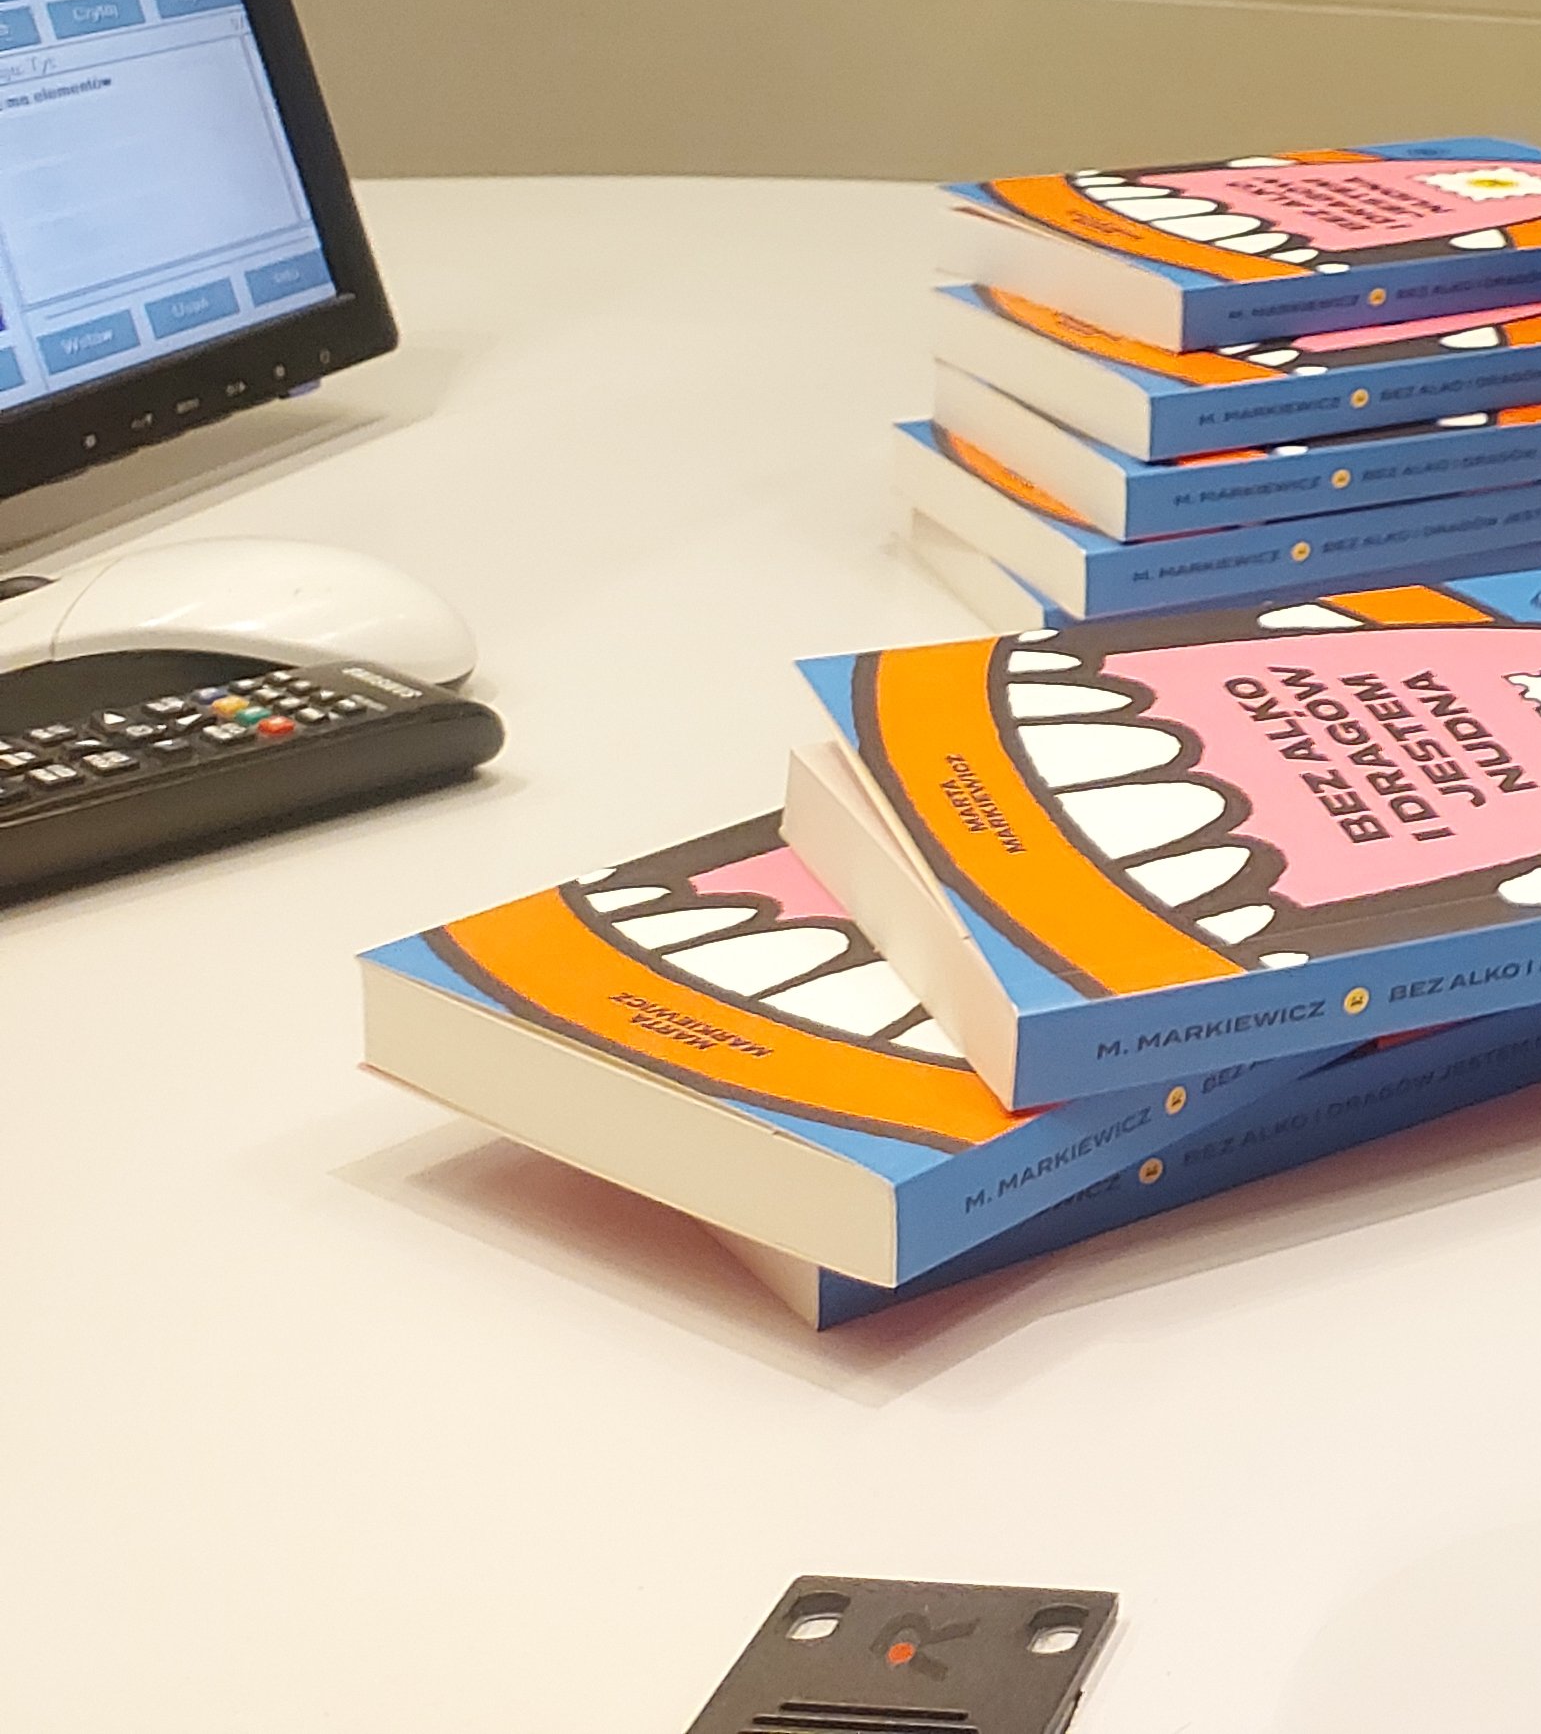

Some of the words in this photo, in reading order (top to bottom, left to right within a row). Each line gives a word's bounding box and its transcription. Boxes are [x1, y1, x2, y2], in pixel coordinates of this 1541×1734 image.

[1223, 676, 1332, 762] ALKO
[1266, 665, 1441, 824] DRAGÓW
[1338, 672, 1487, 809] JESTEM
[1401, 670, 1539, 794] NUDNA
[939, 779, 990, 833] MARTA
[945, 754, 1027, 855] MARKIEWICZ
[1300, 768, 1393, 844] BEZ
[1410, 826, 1457, 842] I
[1388, 975, 1446, 1003] BEZ
[1449, 956, 1519, 990] ALKO
[1525, 957, 1535, 976] I
[608, 992, 775, 1057] MARKIEWICZ
[629, 1013, 719, 1051] MARTA
[1097, 1040, 1129, 1061] M.
[1137, 999, 1327, 1051] MARKIEWICZ
[965, 1189, 992, 1214] M.
[998, 1107, 1151, 1198] MARKIEWICZ
